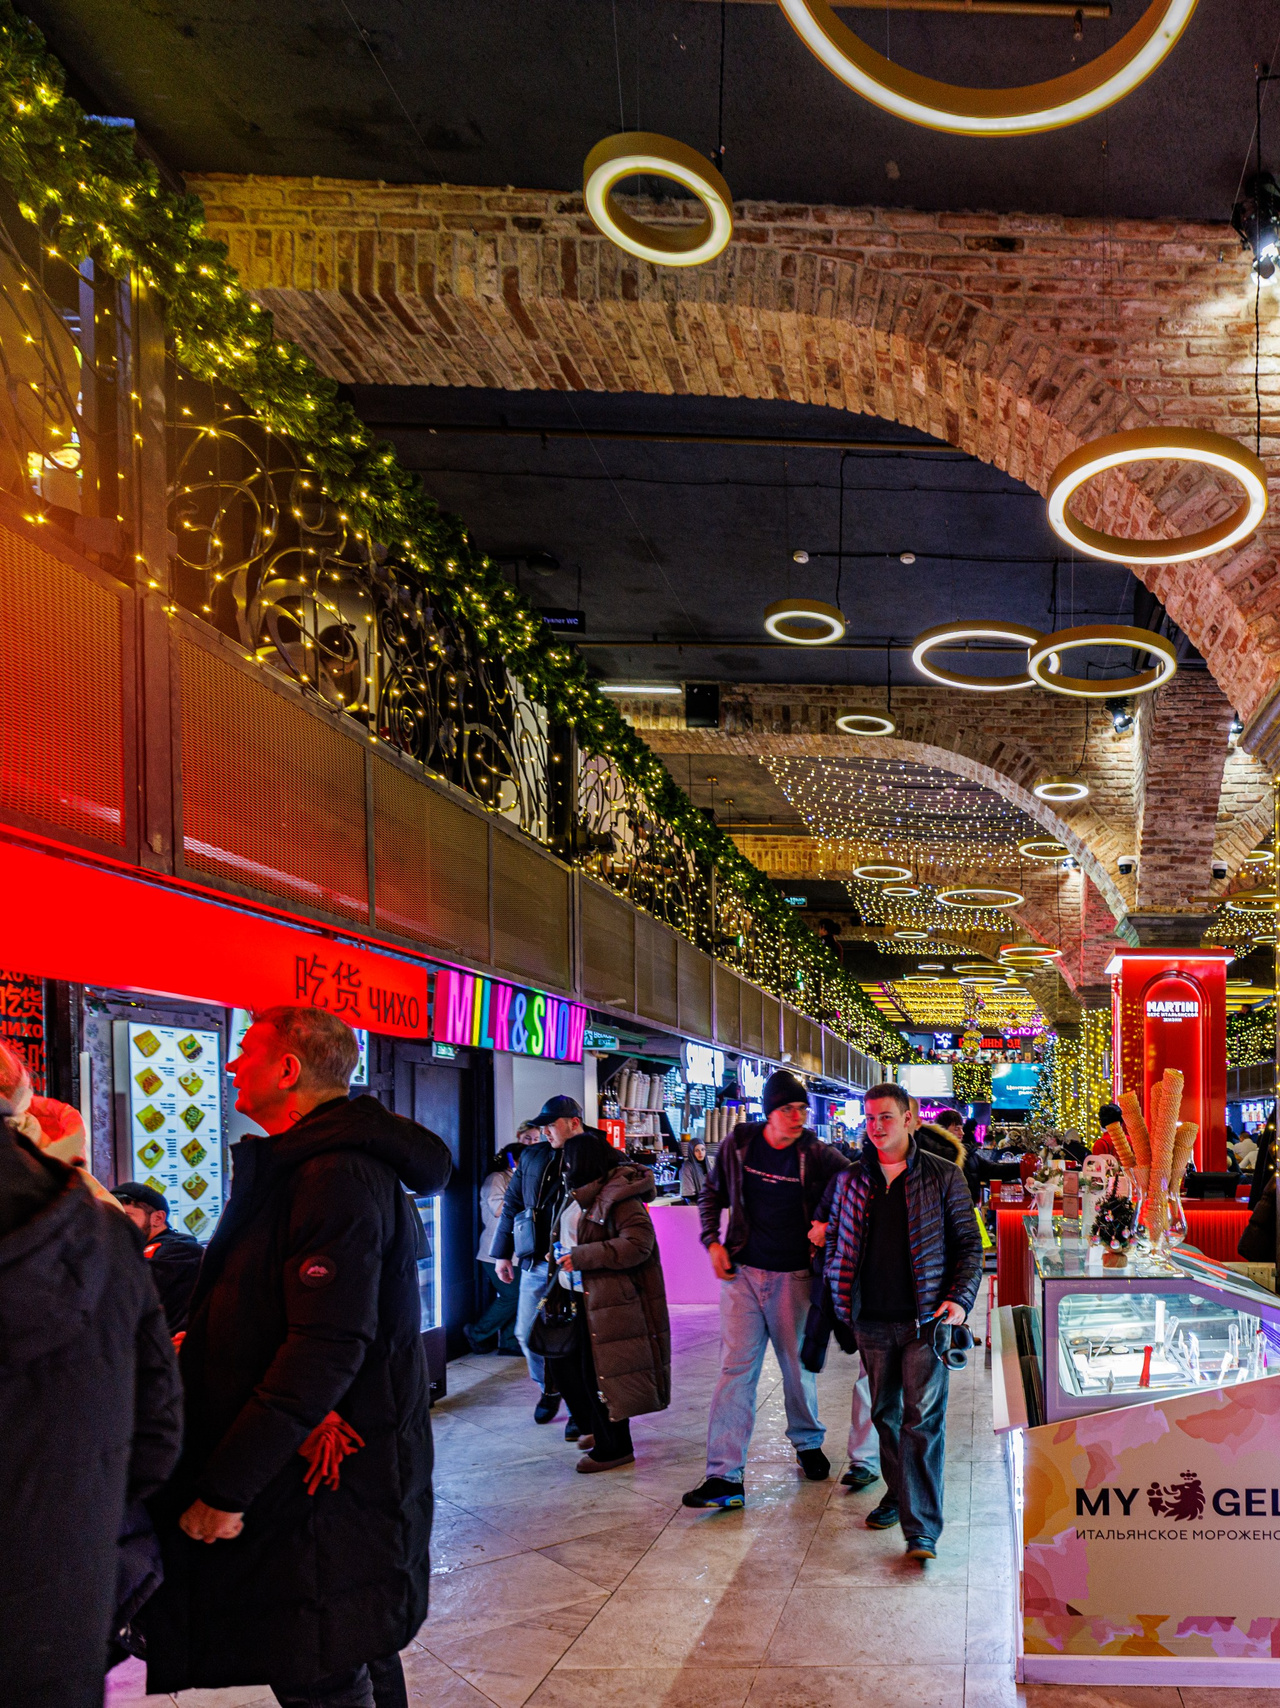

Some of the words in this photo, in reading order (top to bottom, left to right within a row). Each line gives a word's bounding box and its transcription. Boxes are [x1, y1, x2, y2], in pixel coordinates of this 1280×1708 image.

[296, 953, 361, 1018] 吃货
[369, 986, 420, 1029] ЧИХО
[1146, 1001, 1199, 1013] MARTINI
[1075, 1487, 1140, 1516] MY
[1076, 1529, 1188, 1541] ИТАЛЬЯНСКОЕ
